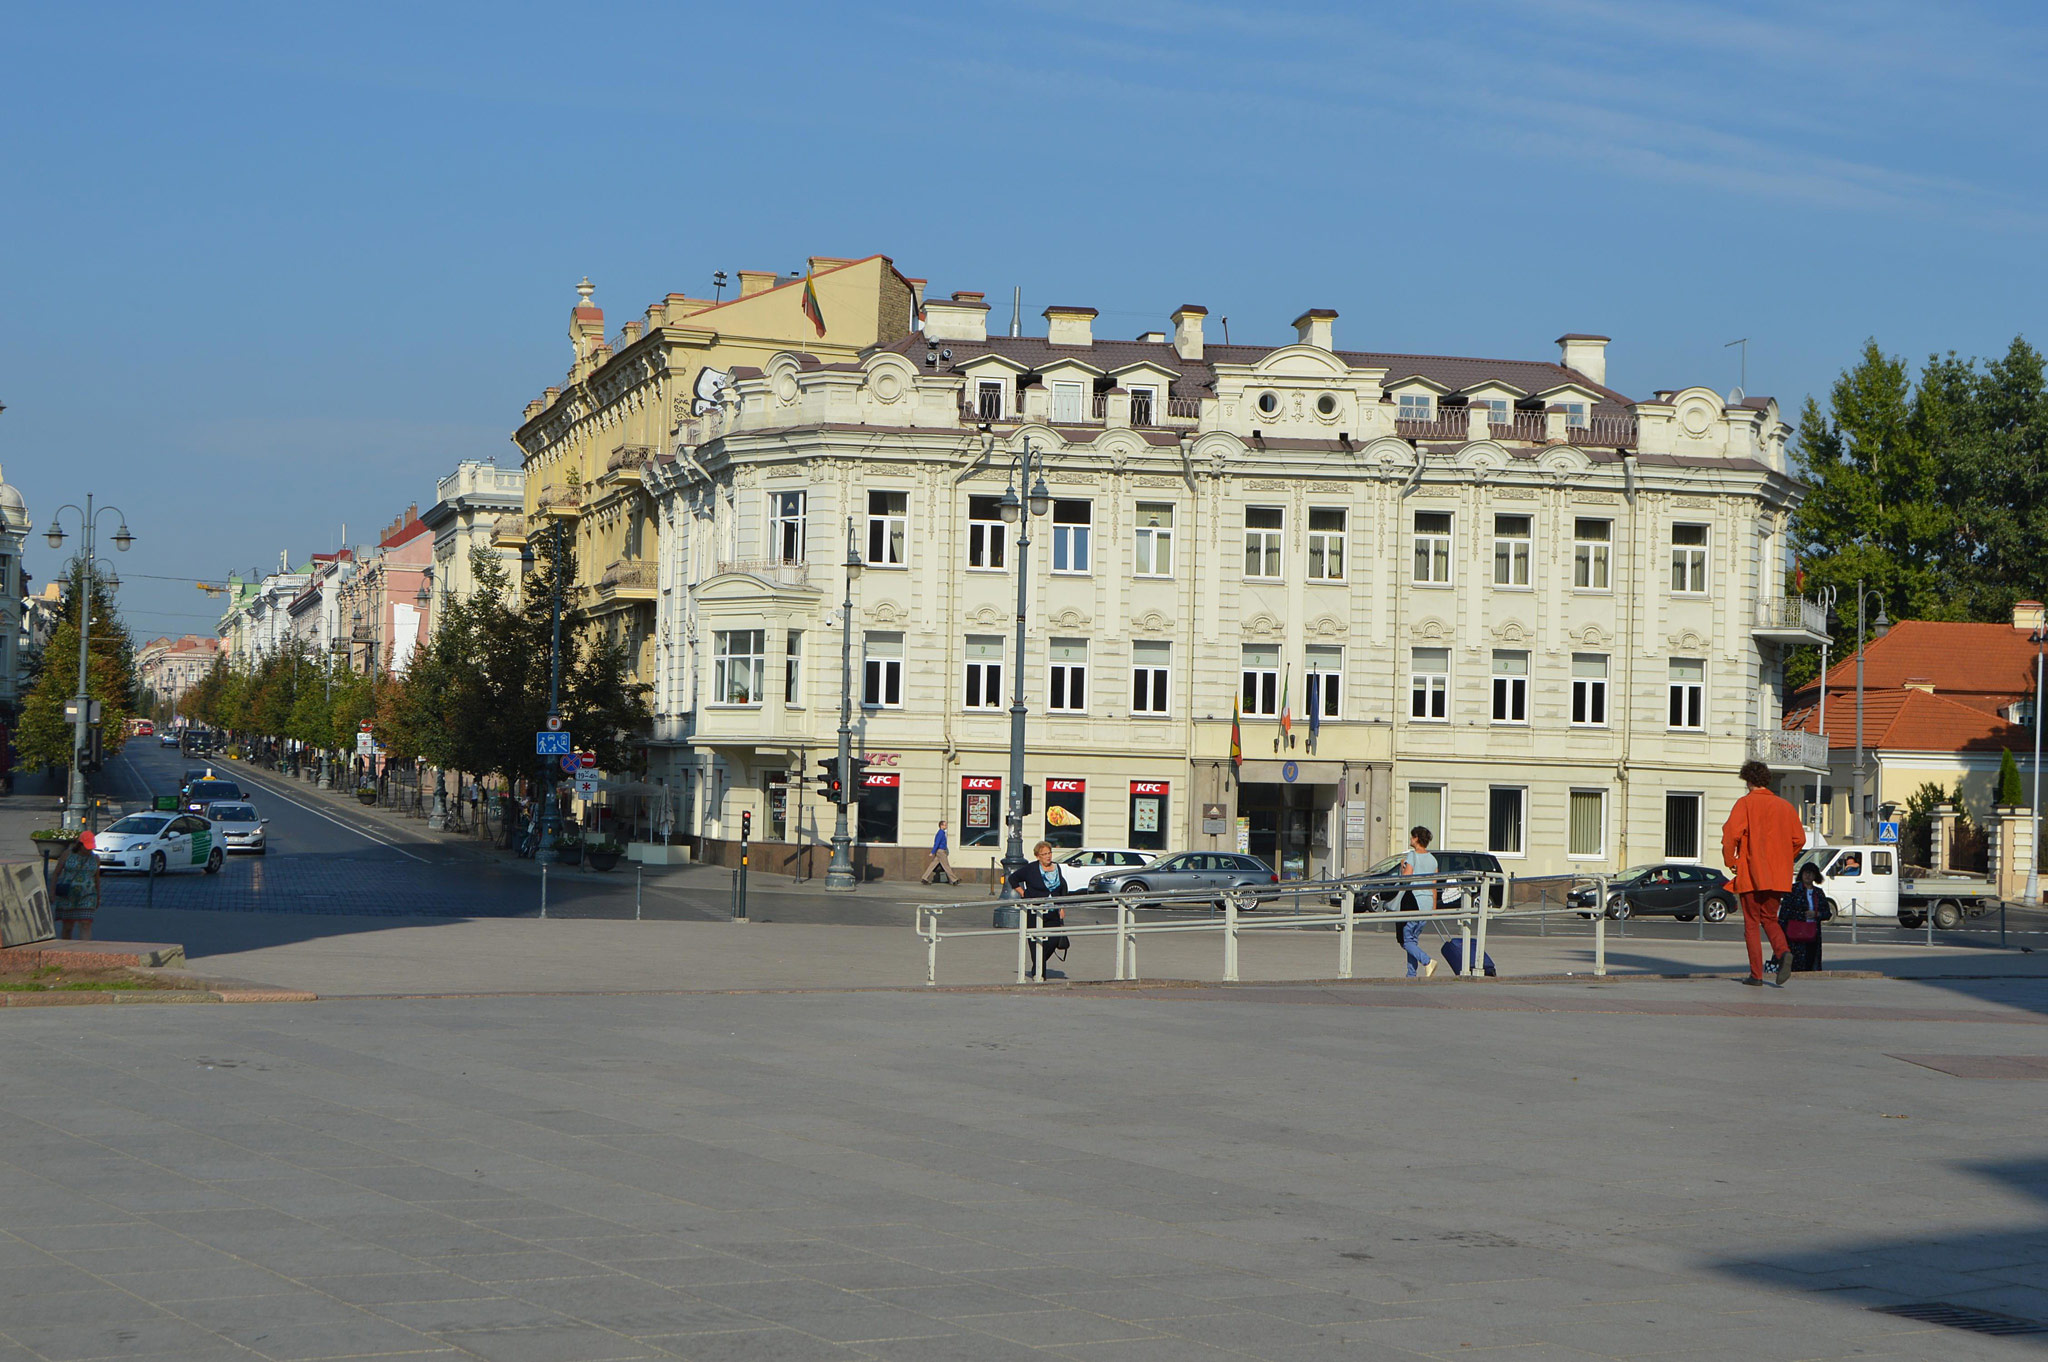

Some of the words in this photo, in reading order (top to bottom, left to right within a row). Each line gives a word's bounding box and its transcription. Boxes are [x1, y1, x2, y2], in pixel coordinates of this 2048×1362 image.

[866, 775, 892, 785] KFC
[968, 778, 994, 788] KFC
[1052, 780, 1077, 790] KFC
[1136, 783, 1161, 792] KFC
